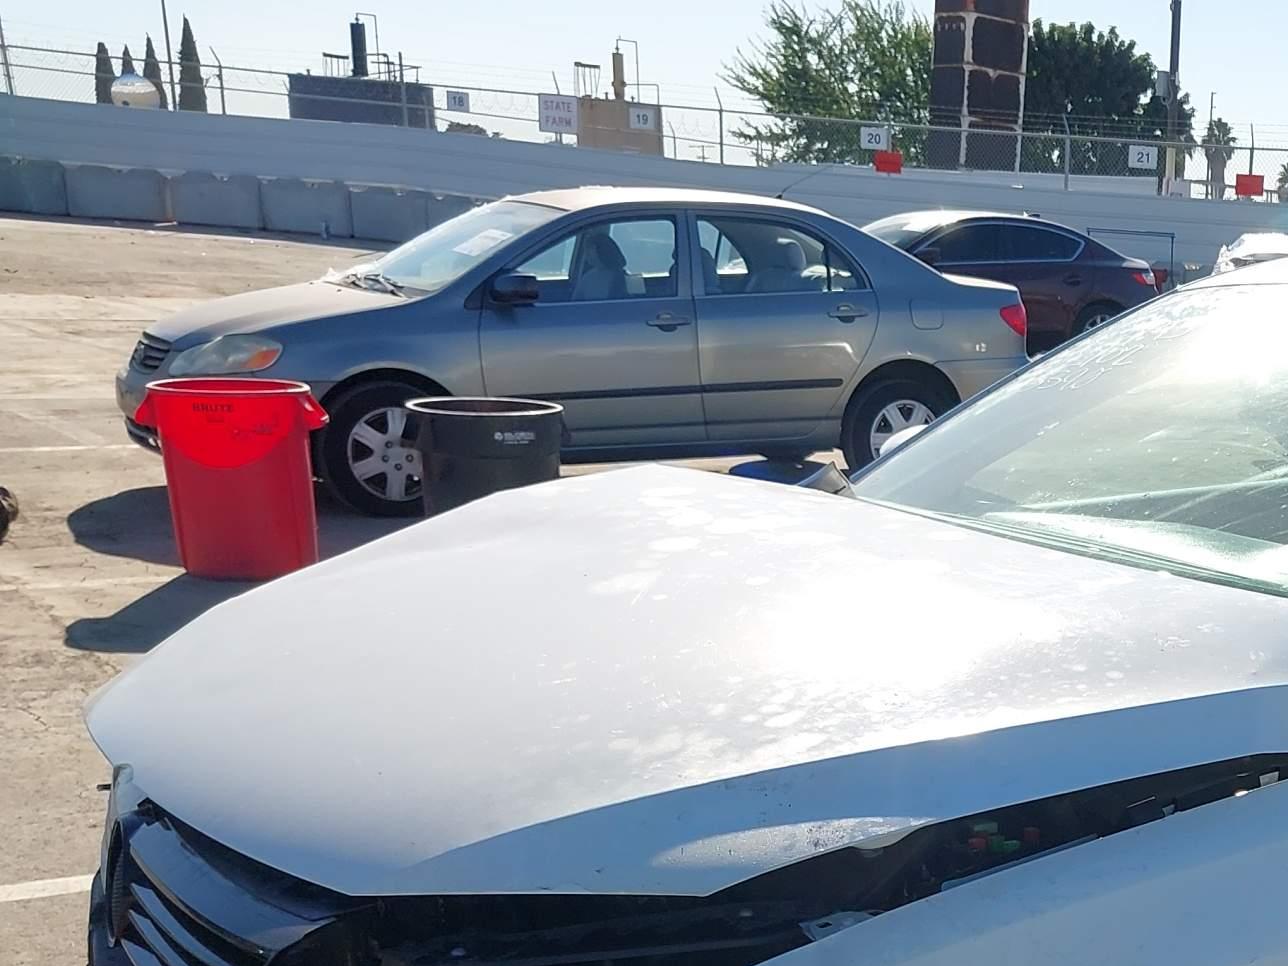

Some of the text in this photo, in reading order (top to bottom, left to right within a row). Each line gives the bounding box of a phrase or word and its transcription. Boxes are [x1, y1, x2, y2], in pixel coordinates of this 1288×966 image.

[451, 95, 465, 107] 18
[543, 99, 573, 113] STATE
[544, 114, 572, 128] FARM
[636, 113, 649, 125] 19
[867, 132, 881, 145] 20
[1136, 151, 1151, 164] 21
